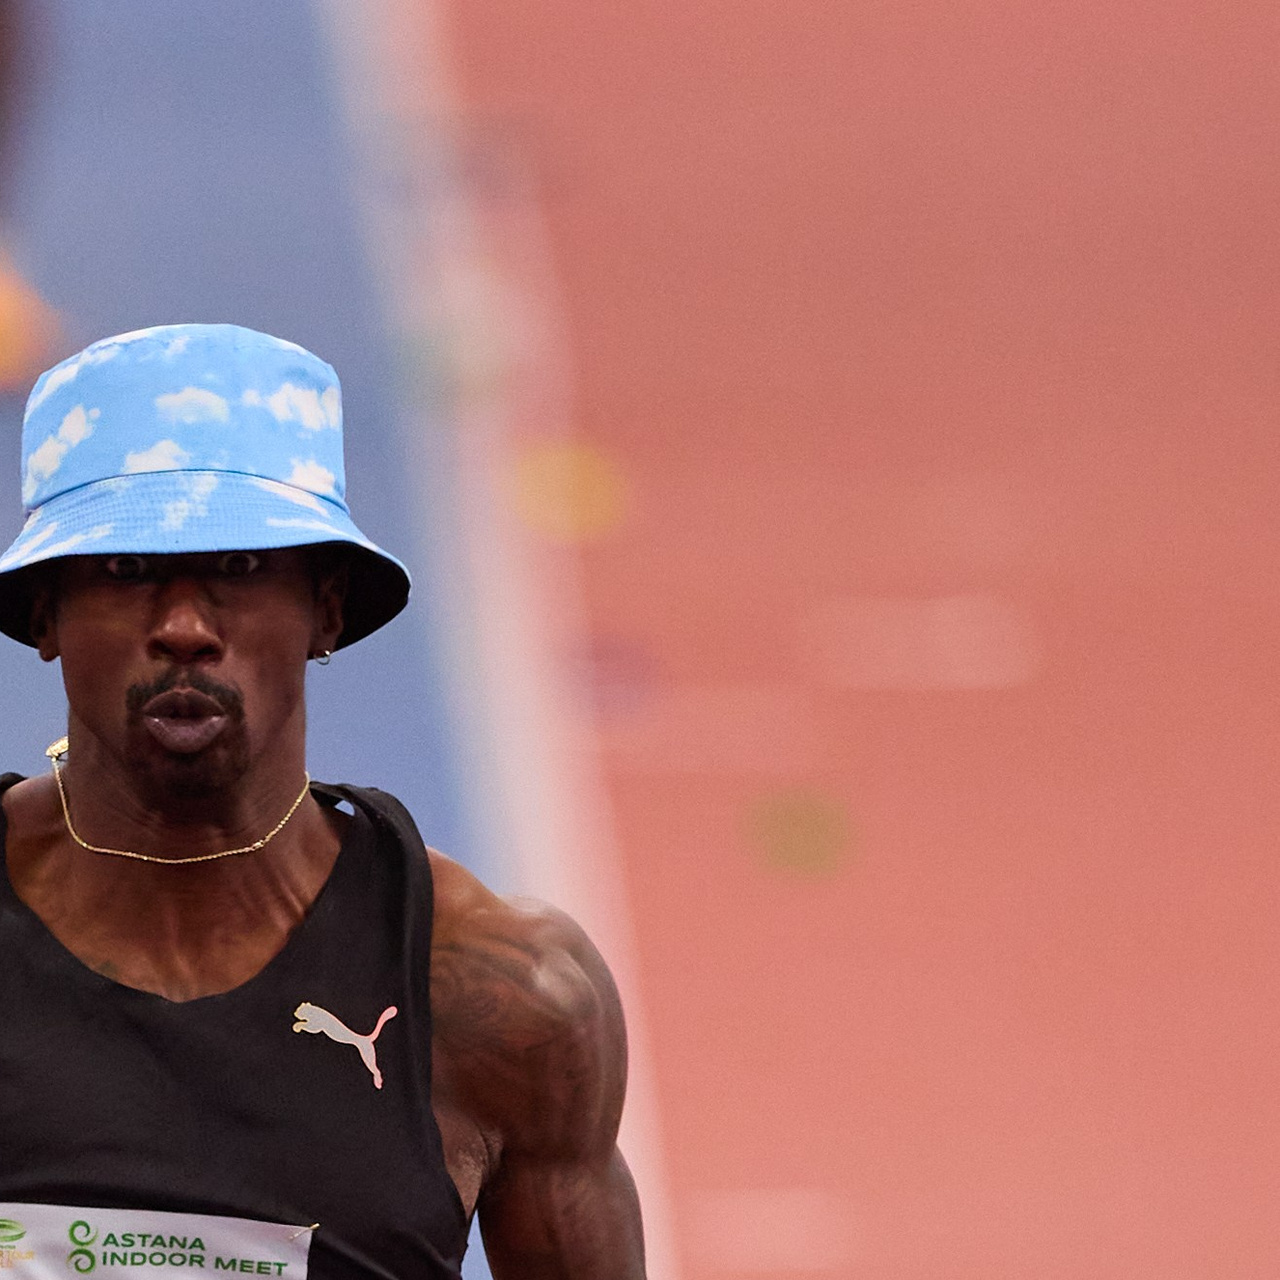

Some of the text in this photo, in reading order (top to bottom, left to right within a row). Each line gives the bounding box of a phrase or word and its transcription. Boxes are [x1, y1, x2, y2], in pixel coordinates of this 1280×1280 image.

[102, 1232, 206, 1251] ASTANA
[102, 1251, 288, 1276] INDOOR MEET
